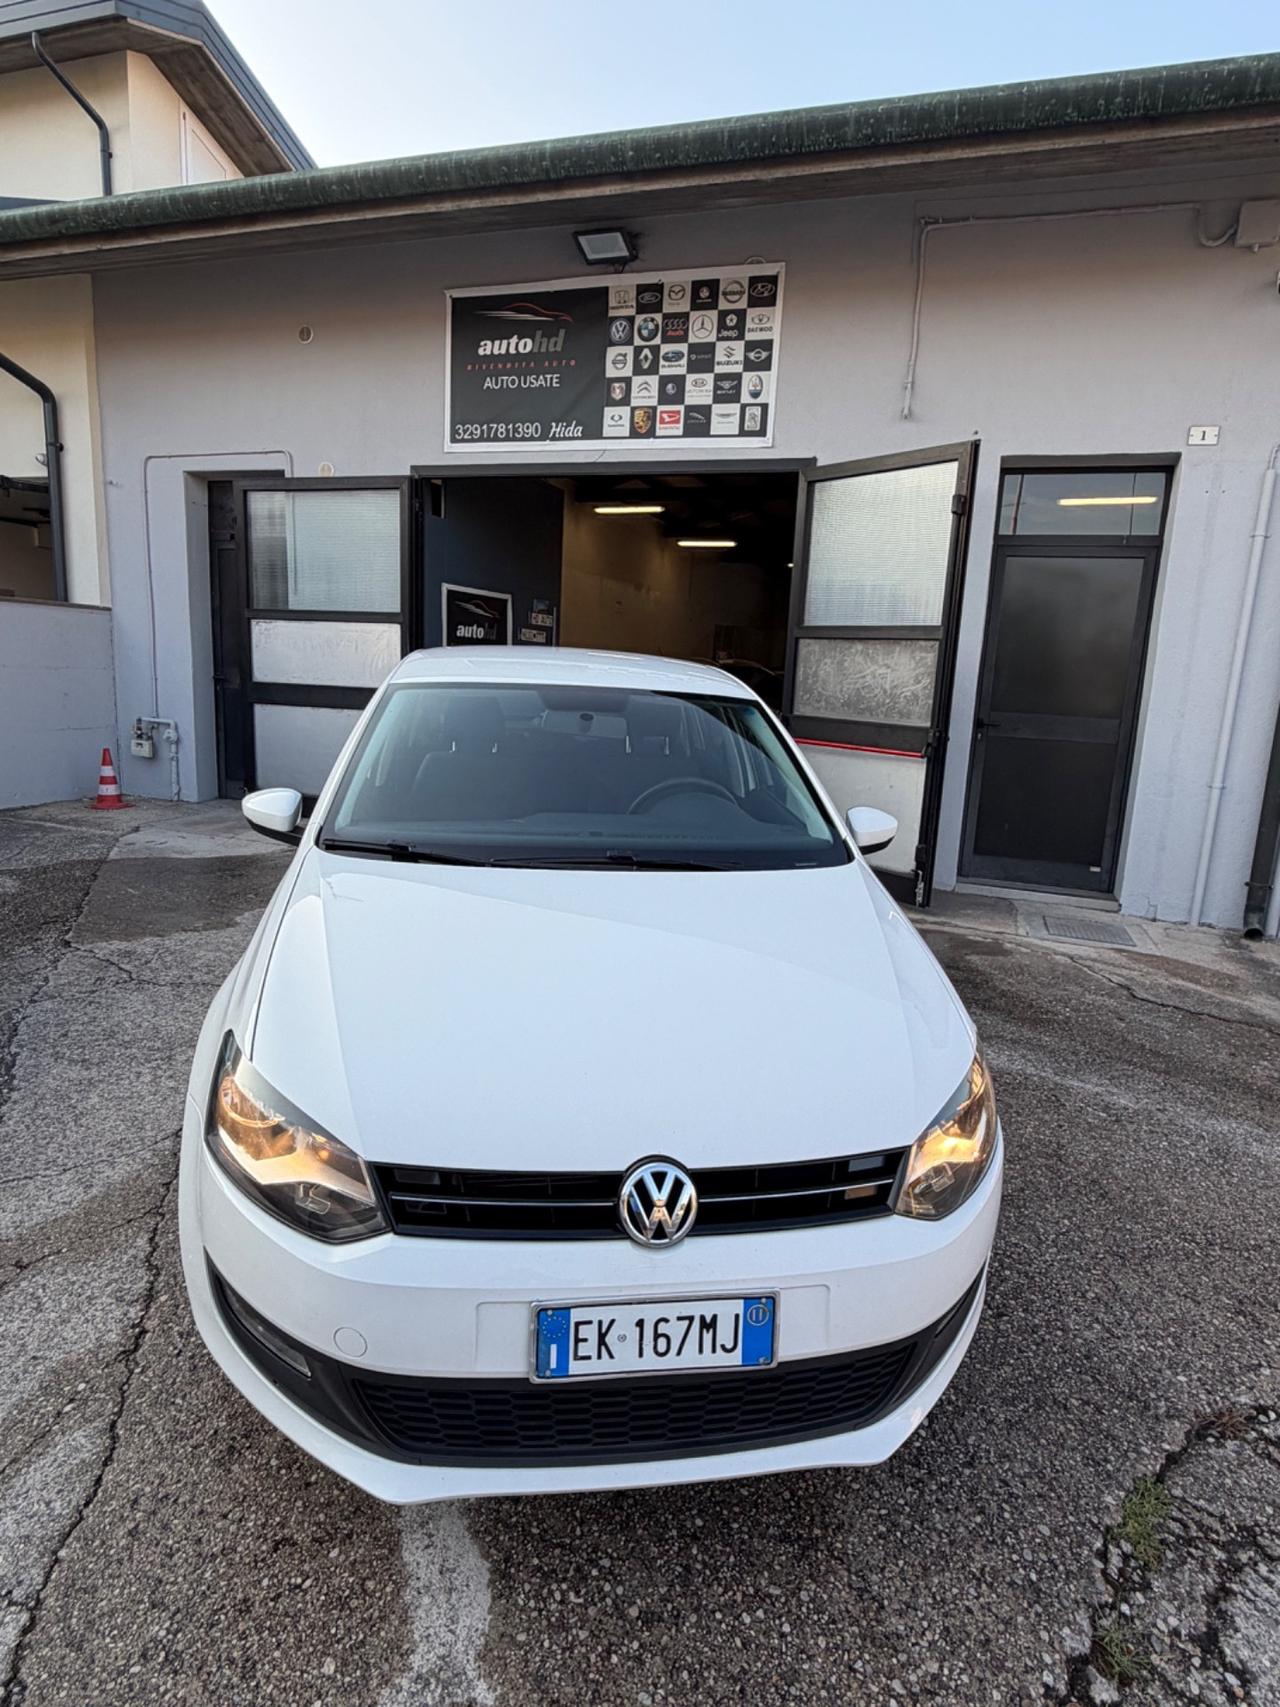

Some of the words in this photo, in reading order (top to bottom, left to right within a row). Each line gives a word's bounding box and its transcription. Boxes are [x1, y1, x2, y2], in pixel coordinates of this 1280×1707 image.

[718, 328, 739, 338] Jeep
[747, 326, 773, 334] DAEWOO
[478, 328, 566, 356] autohd
[483, 376, 519, 390] AUTO
[520, 374, 561, 388] USATE
[454, 421, 542, 440] 3291781390
[549, 420, 584, 438] Hida
[1200, 430, 1206, 441] 1
[572, 1318, 617, 1362] EK
[634, 1312, 741, 1359] 167MJ
